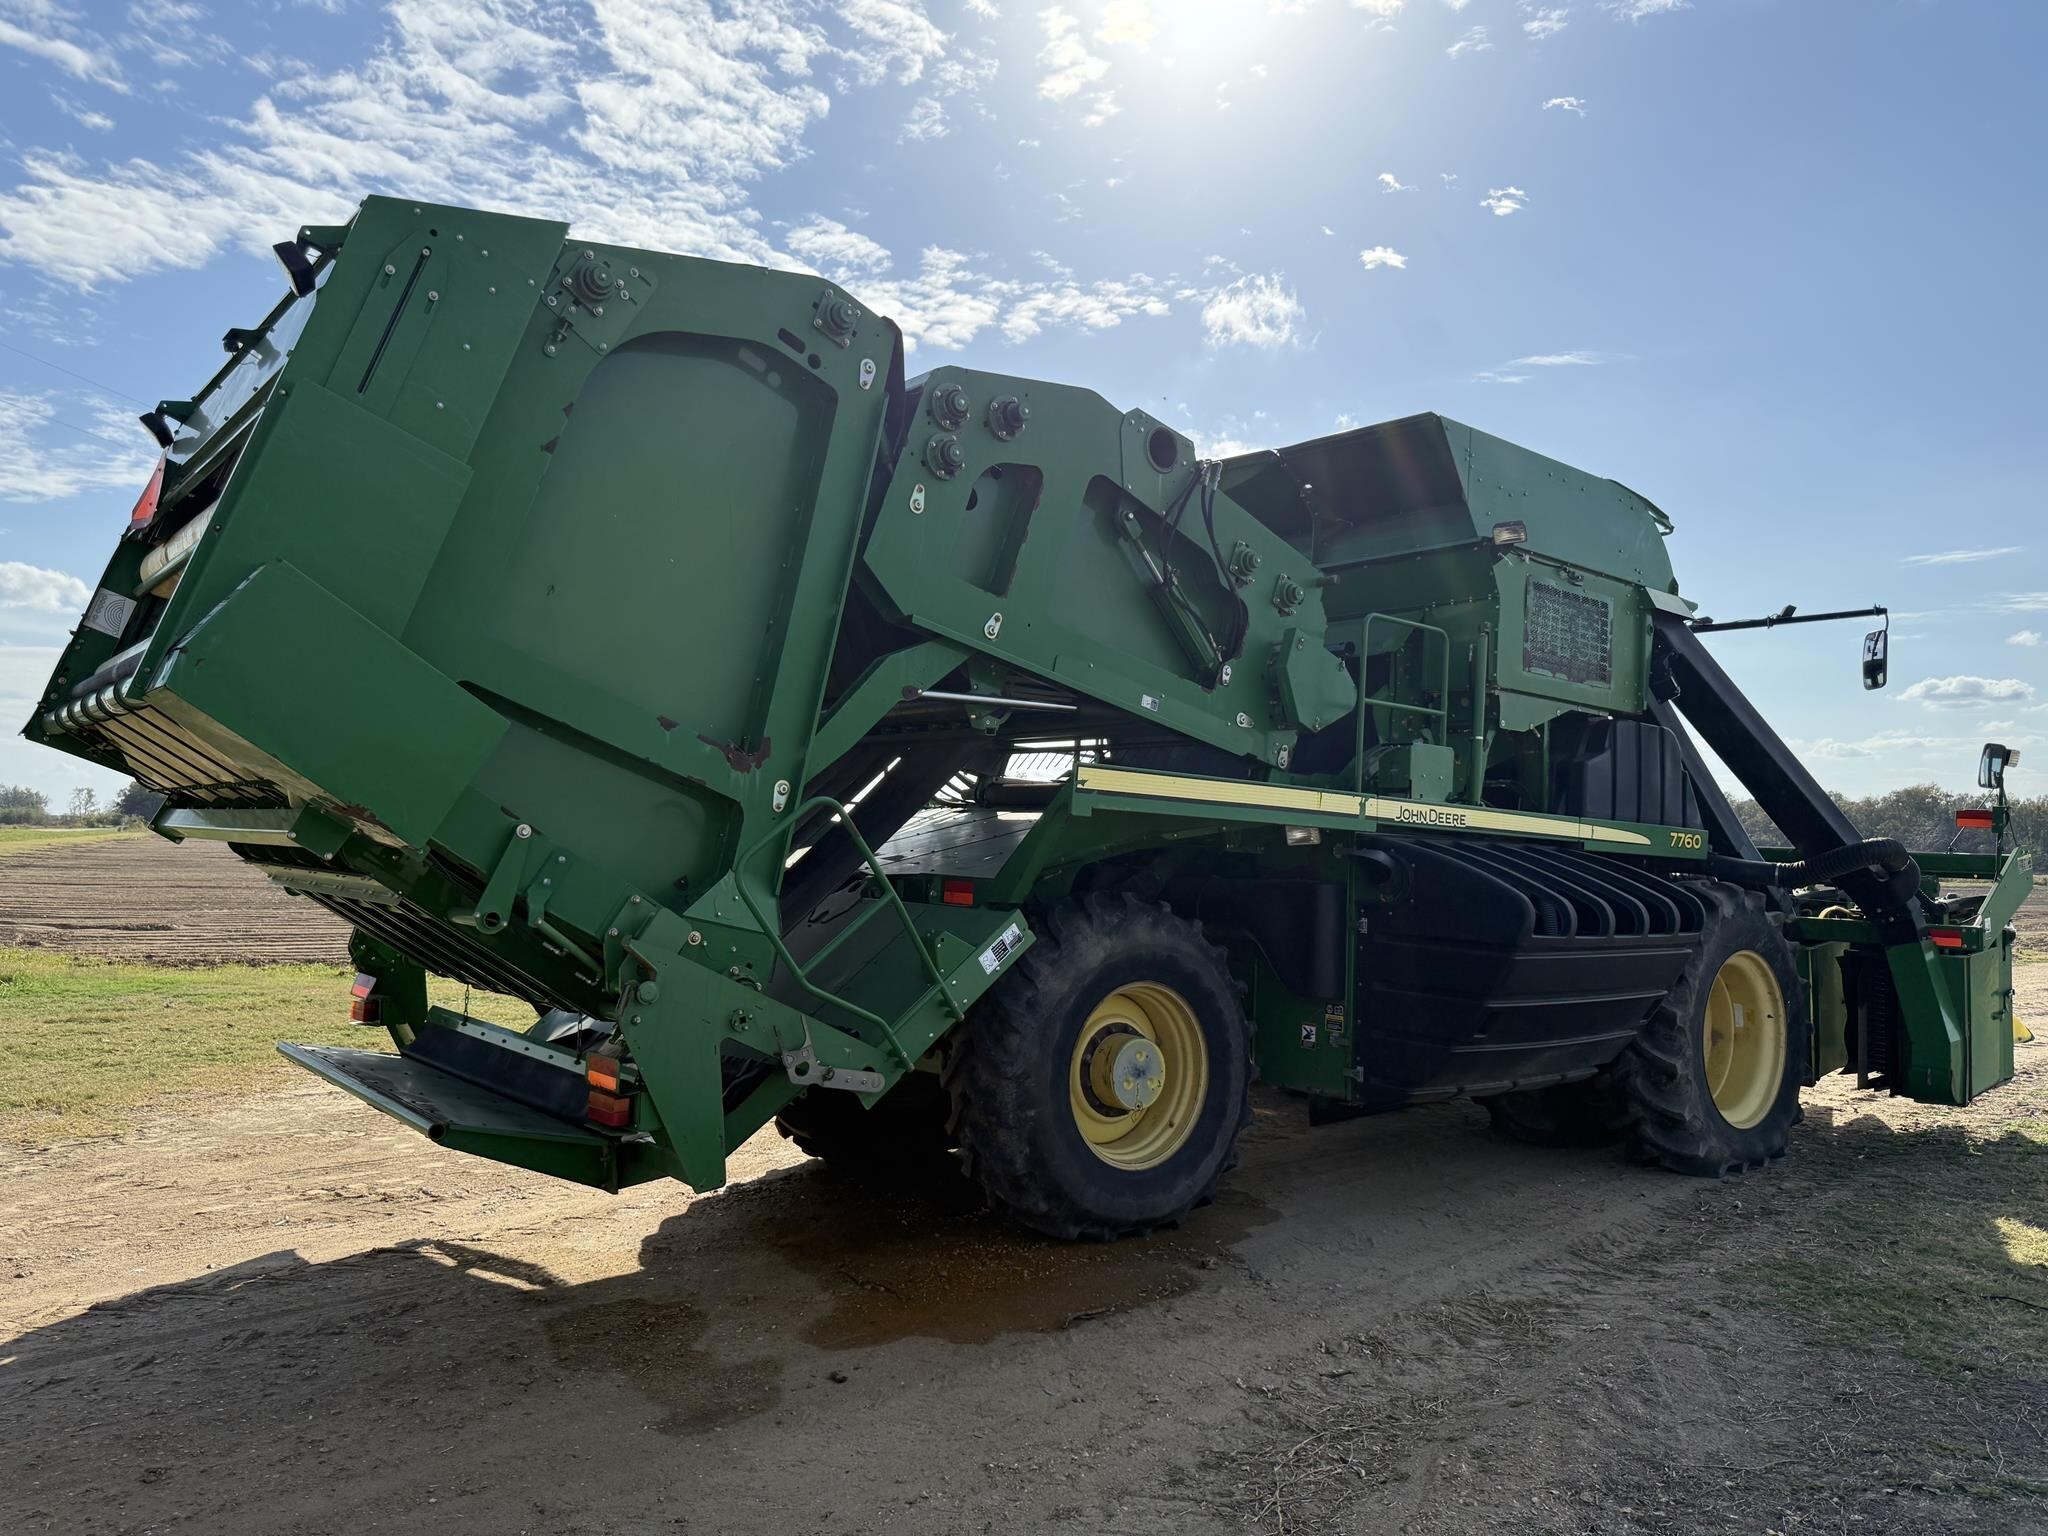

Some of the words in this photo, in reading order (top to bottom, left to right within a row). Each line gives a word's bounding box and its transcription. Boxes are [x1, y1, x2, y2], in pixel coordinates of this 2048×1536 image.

[1395, 805, 1427, 822] JOHN
[1429, 808, 1467, 826] DEERE
[1670, 832, 1702, 849] 7760
